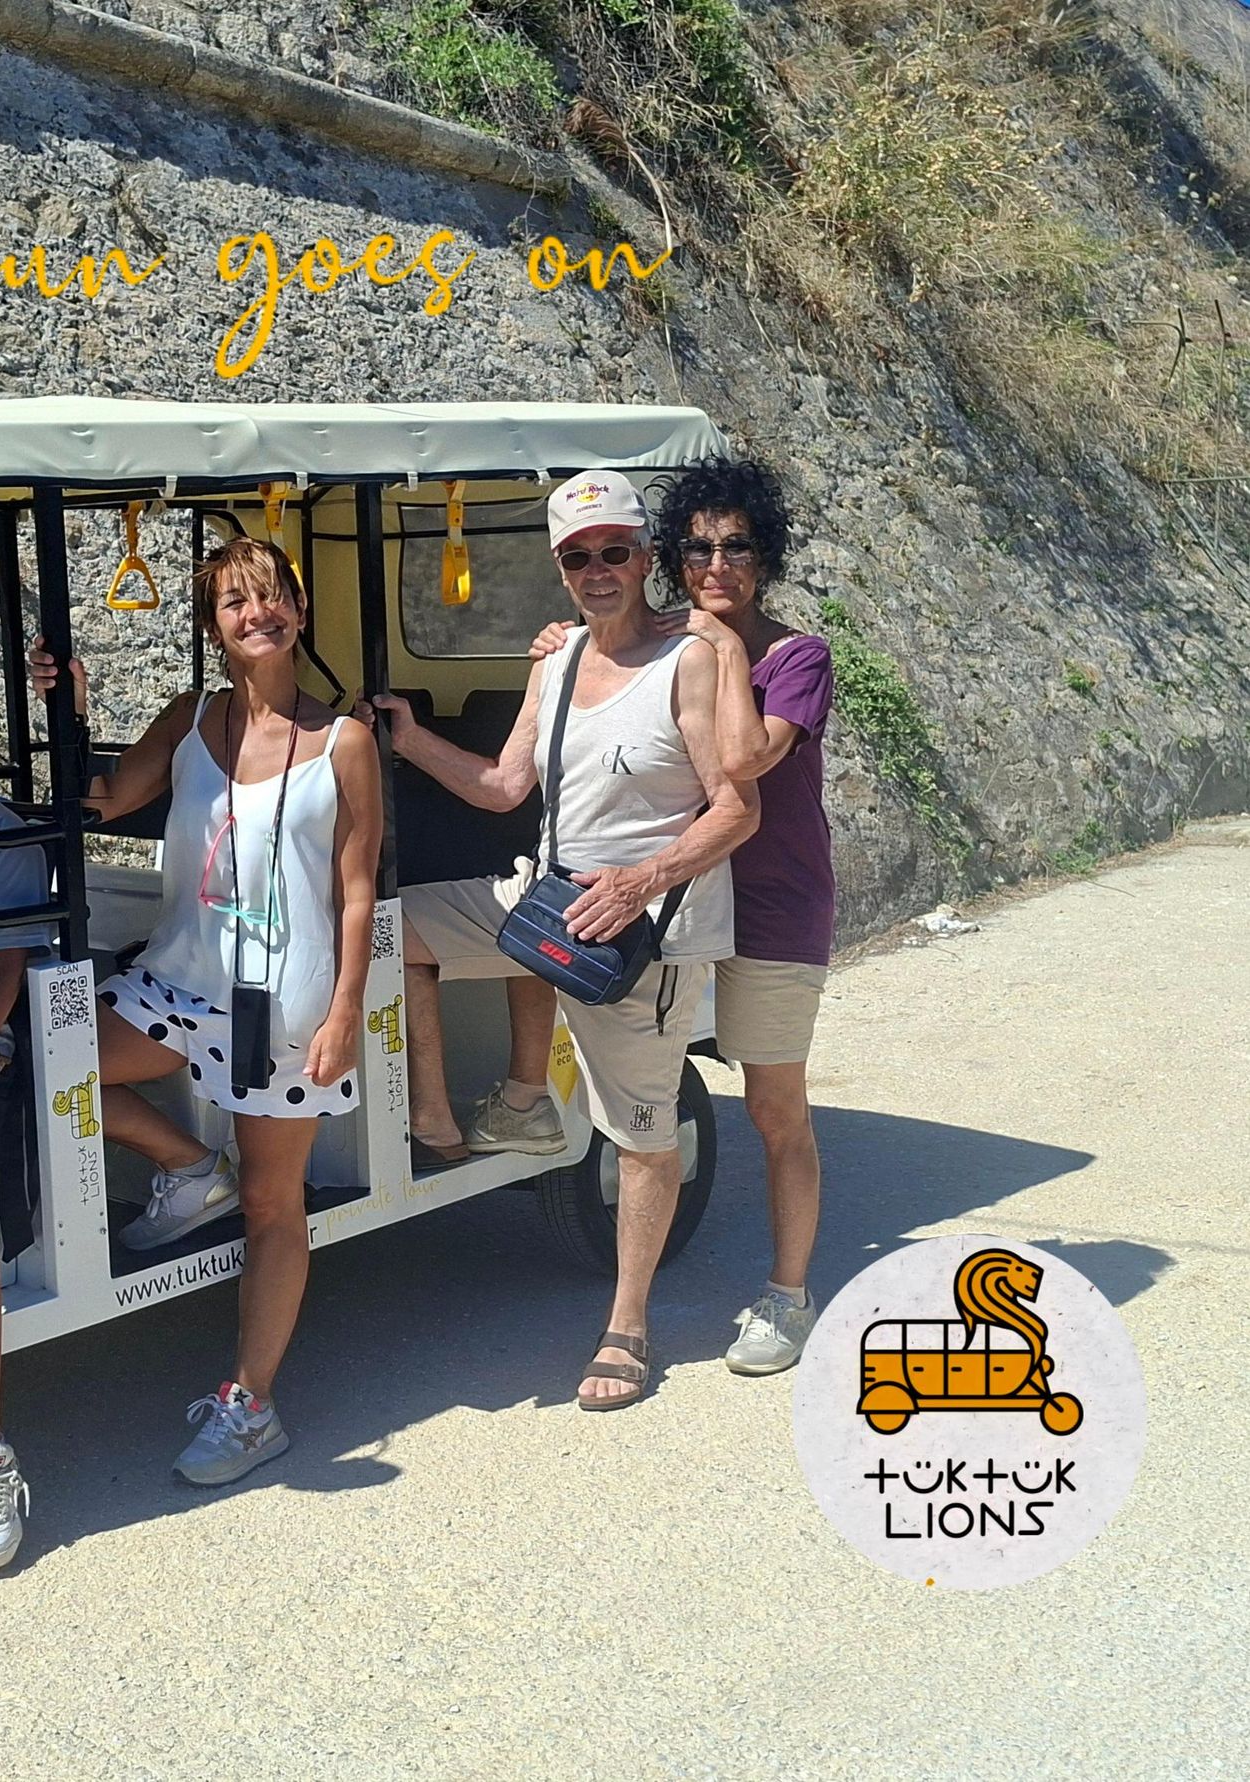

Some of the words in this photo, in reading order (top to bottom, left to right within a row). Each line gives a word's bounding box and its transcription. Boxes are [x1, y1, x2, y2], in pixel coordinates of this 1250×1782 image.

[56, 963, 79, 976] SCAN
[556, 1054, 572, 1066] eco
[395, 1065, 404, 1107] LIONS
[88, 1150, 100, 1198] LIONS
